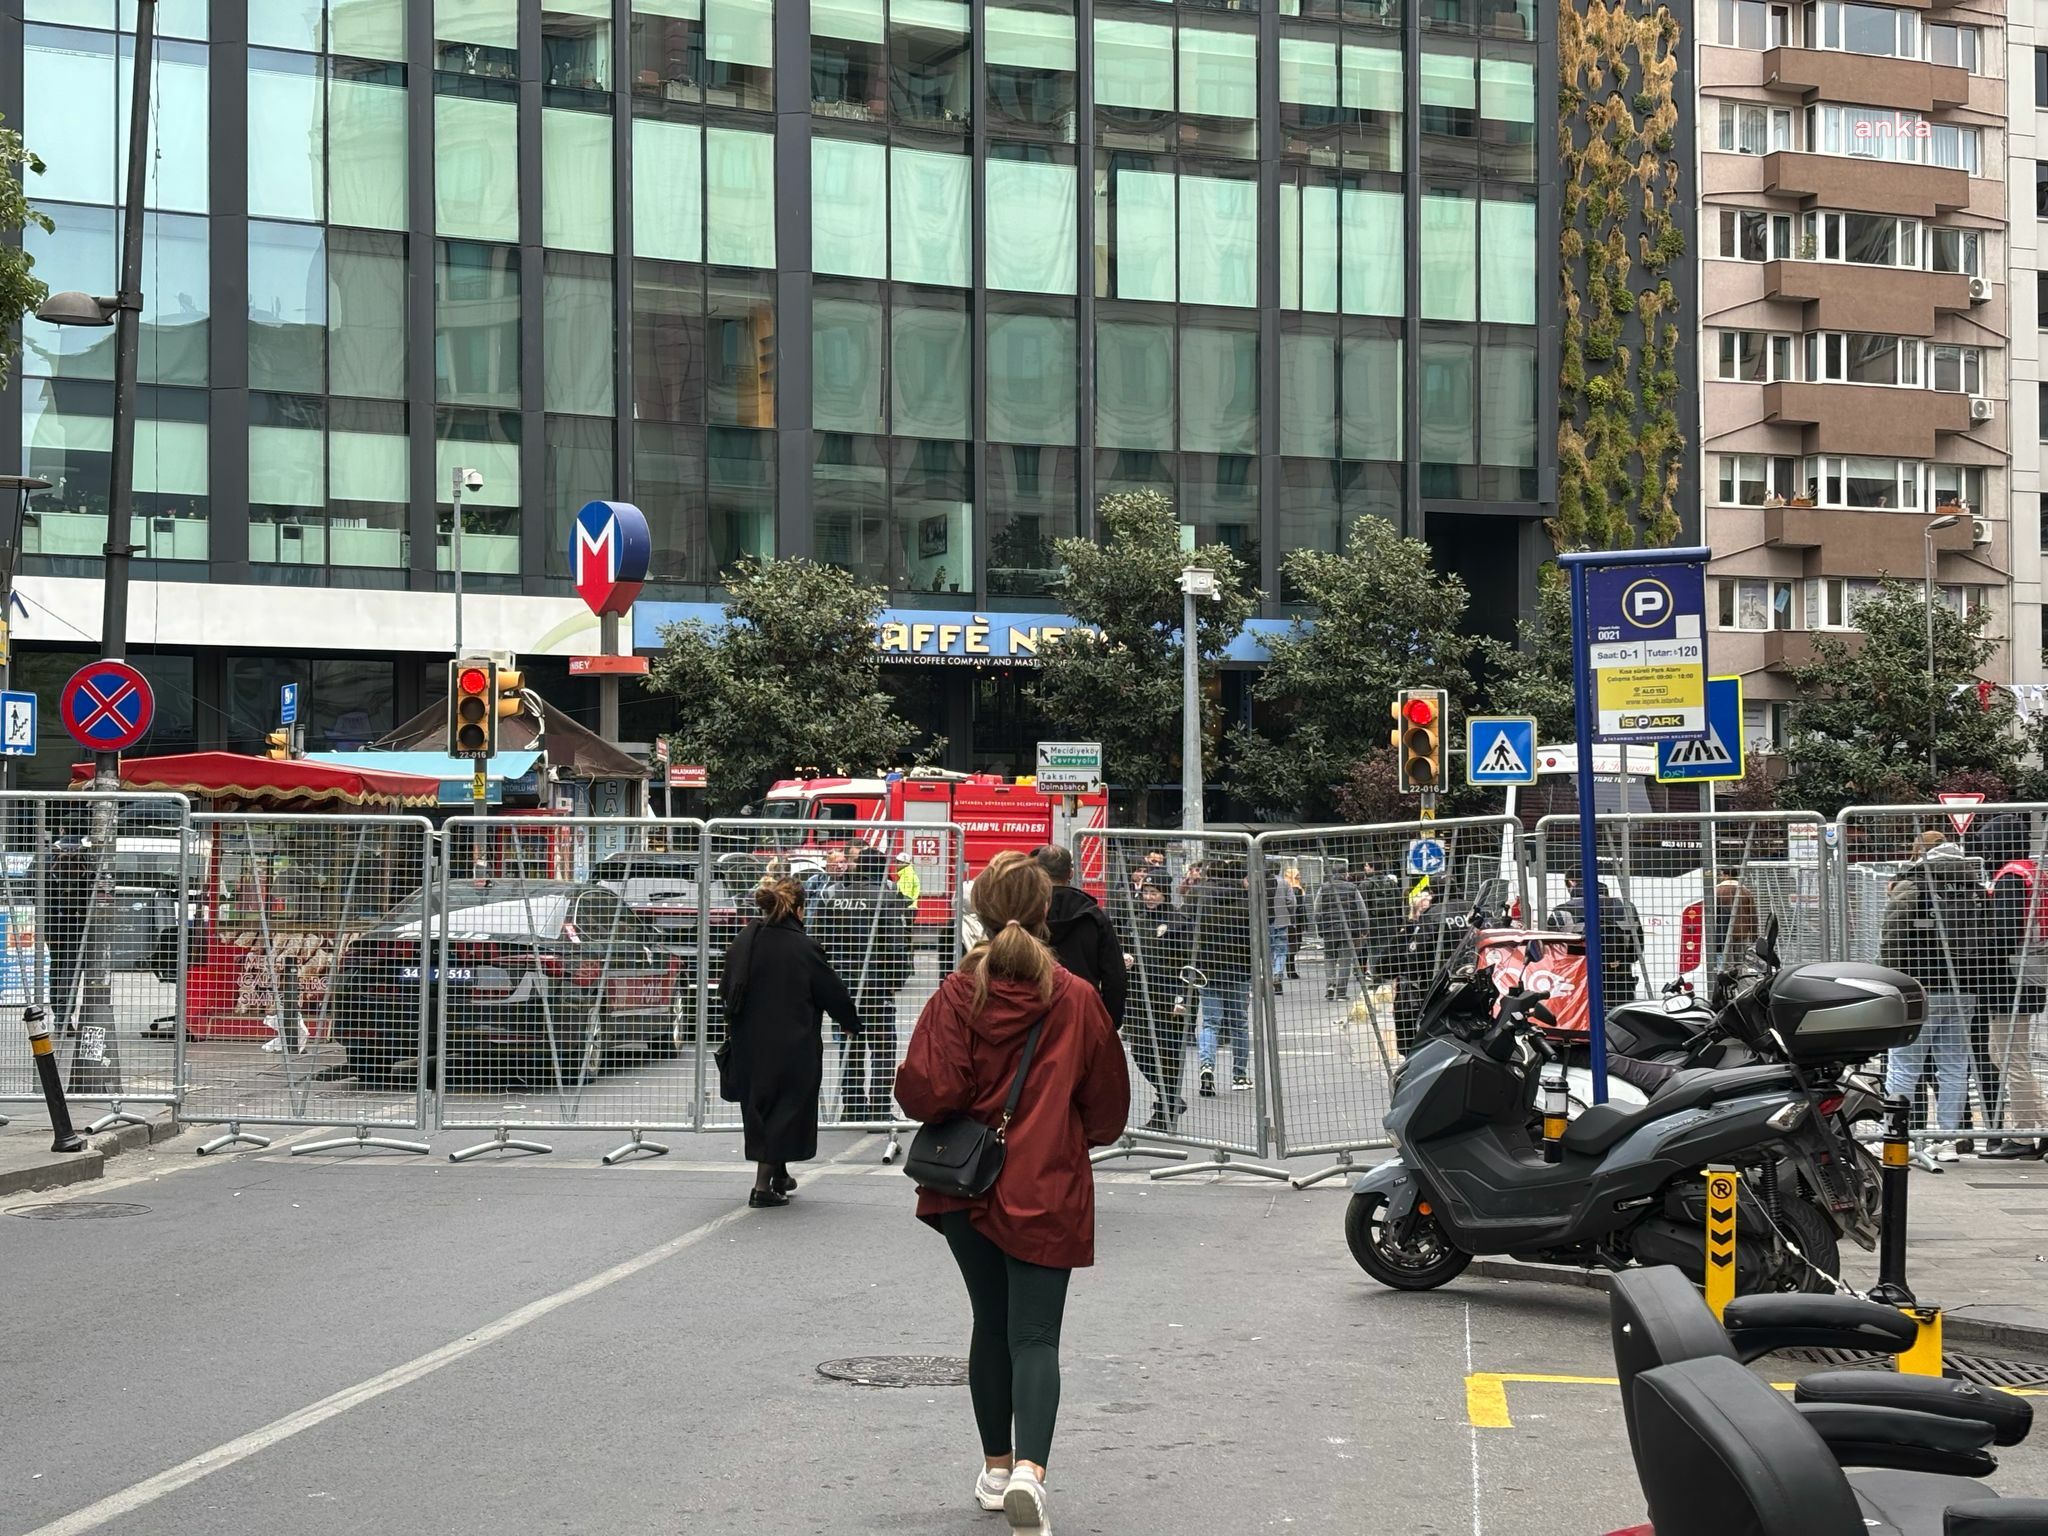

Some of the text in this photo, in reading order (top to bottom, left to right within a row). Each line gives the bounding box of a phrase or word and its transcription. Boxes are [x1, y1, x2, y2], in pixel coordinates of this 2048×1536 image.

[1855, 111, 1931, 138] anka
[577, 513, 615, 586] M
[1634, 591, 1663, 616] P
[1597, 630, 1620, 641] 0021
[1597, 649, 1619, 660] Saat:
[1619, 649, 1639, 660] 0-1
[1647, 649, 1673, 658] Tutar:
[876, 656, 912, 664] ITALIAN
[913, 656, 946, 665] COFFEE
[947, 657, 991, 666] COMPANY
[992, 658, 1012, 667] AND
[459, 751, 487, 759] 22-016
[1409, 785, 1440, 793] 22-016
[916, 840, 936, 855] 112
[403, 968, 419, 978] 34
